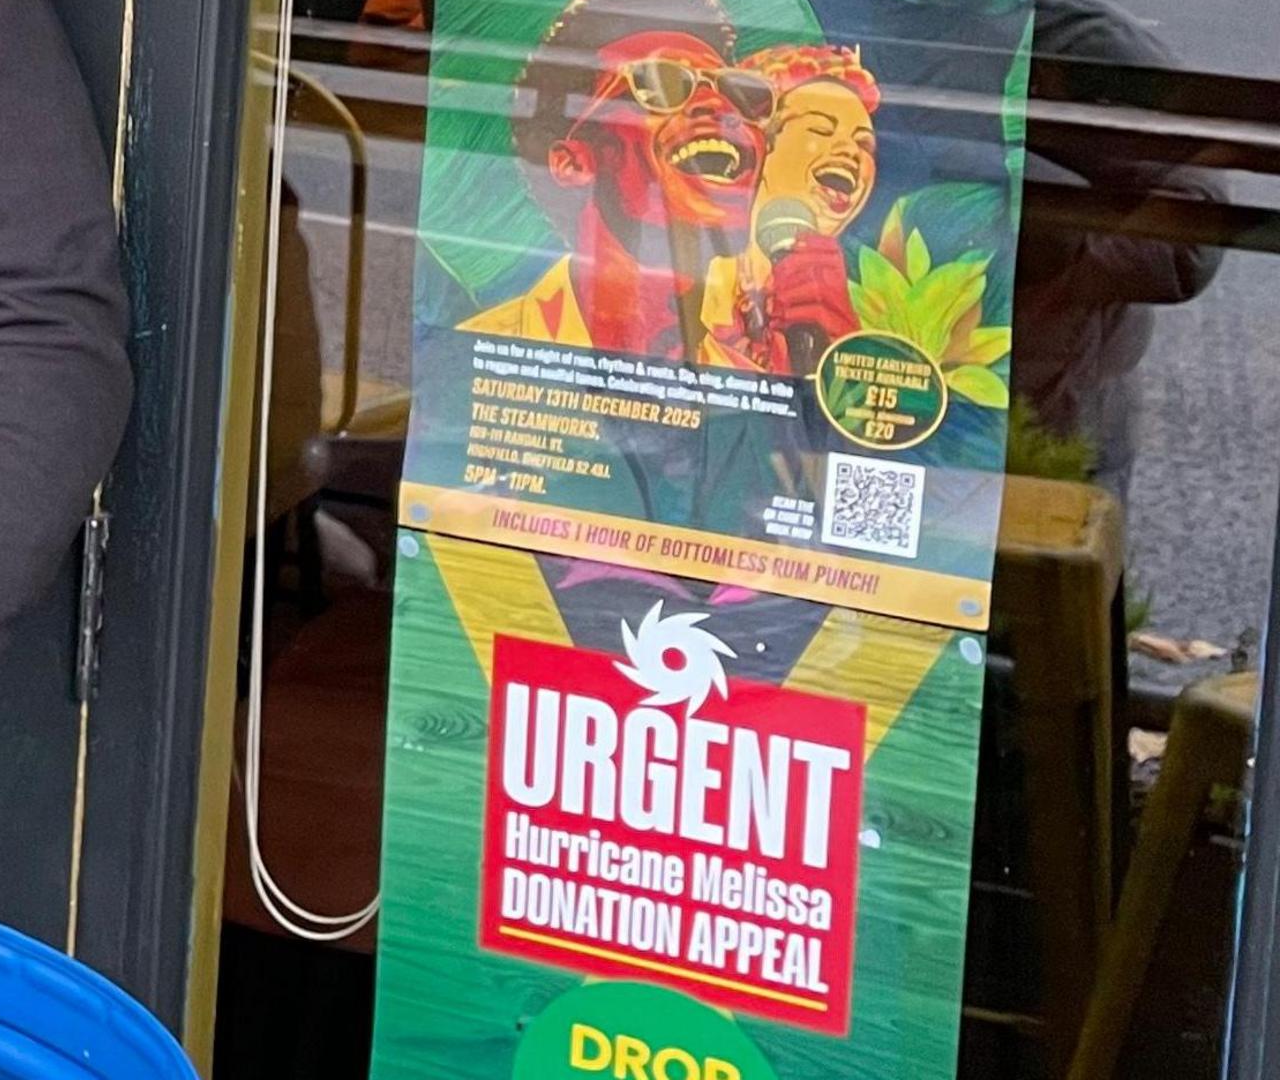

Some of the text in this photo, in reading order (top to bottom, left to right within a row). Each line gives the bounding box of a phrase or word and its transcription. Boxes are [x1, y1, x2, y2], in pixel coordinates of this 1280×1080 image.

[472, 377, 701, 429] SATURDAY 13TH DECEMBER 2025
[865, 386, 898, 408] £15
[472, 402, 600, 440] THE STEAMWORKS.
[504, 431, 546, 449] RANDALL
[864, 421, 895, 440] £20
[464, 464, 546, 494] 5PM 11PM.
[523, 453, 574, 472] SHEFFIELD
[492, 507, 570, 541] INCLUDES
[585, 524, 630, 552] HOUR
[636, 533, 657, 554] OF
[661, 537, 768, 574] BOTTOMLESS
[771, 557, 810, 582] RUM
[814, 563, 879, 596] PUNCH!
[502, 683, 851, 869] URGENT
[505, 811, 830, 931] Hurricane Melissa
[501, 867, 828, 993] DONATION APPEAL
[570, 1023, 740, 1080] DROP
